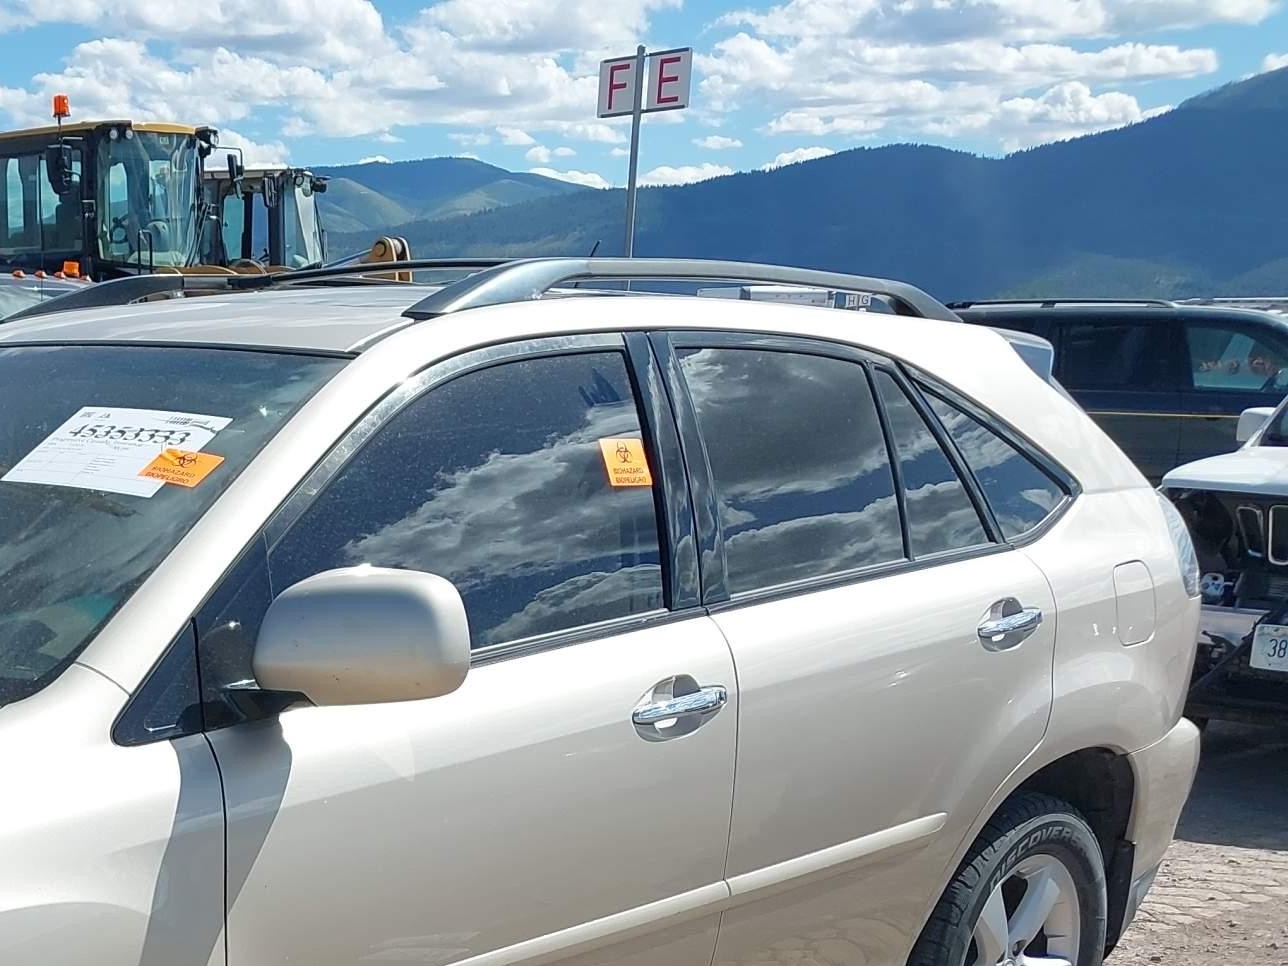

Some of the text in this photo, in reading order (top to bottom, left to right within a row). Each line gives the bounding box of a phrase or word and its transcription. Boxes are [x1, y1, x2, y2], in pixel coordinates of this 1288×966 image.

[607, 63, 631, 110] F
[656, 56, 682, 105] E
[68, 424, 191, 446] 45353333
[152, 465, 196, 478] BIOHAZARD
